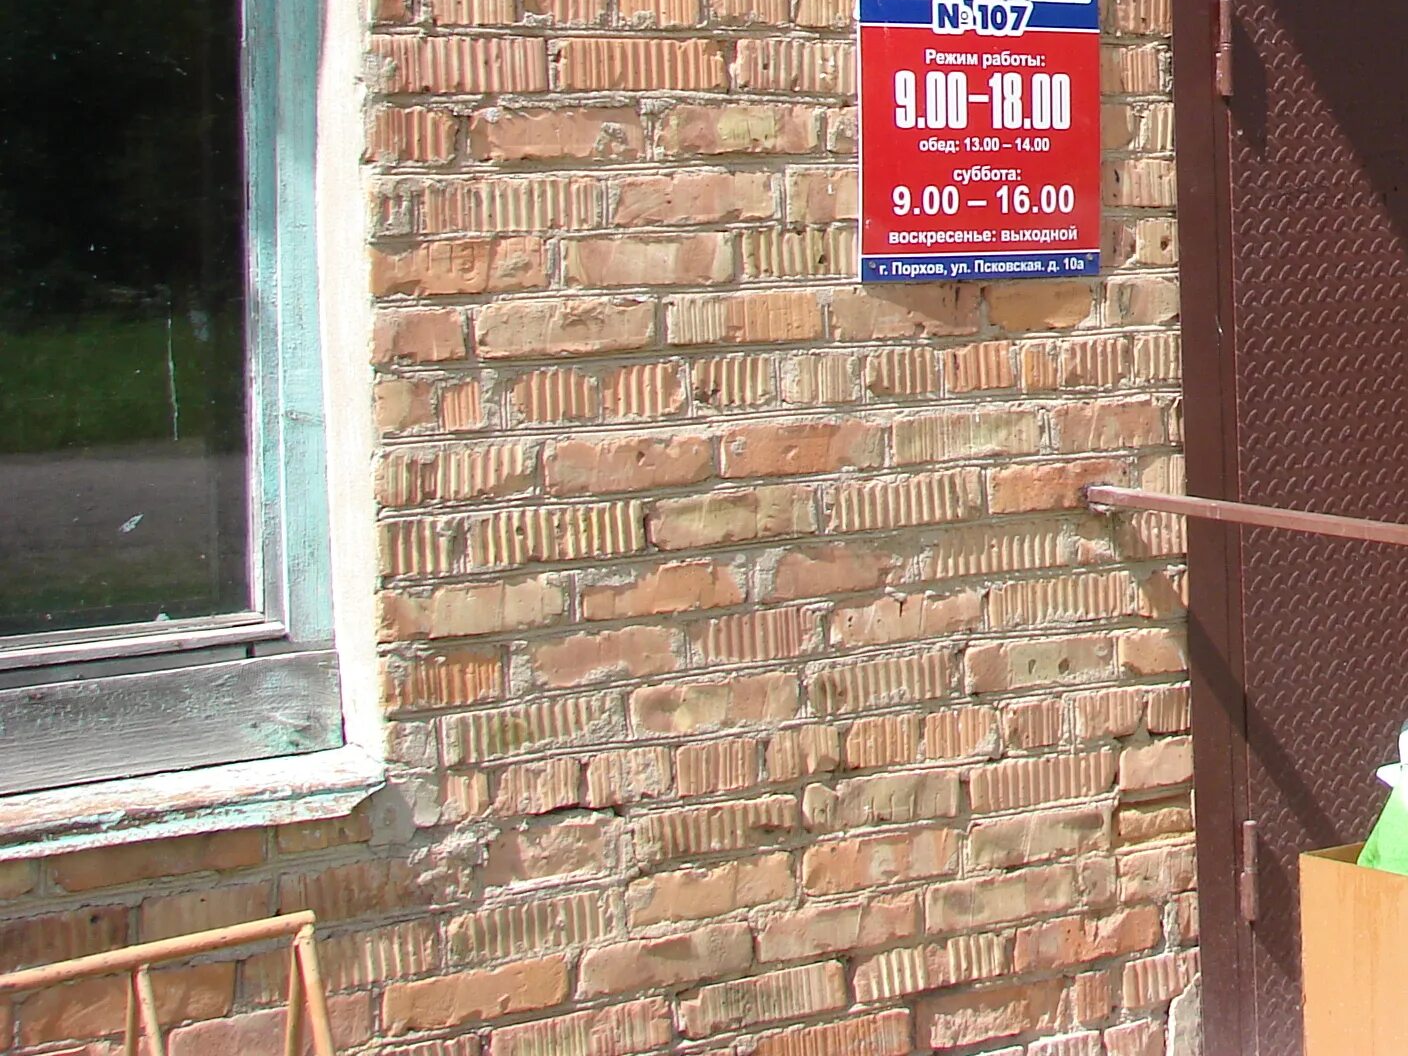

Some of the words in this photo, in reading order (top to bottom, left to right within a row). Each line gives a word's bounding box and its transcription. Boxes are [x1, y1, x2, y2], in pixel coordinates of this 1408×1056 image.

[938, 3, 969, 29] №
[979, 4, 1027, 31] 107
[925, 49, 978, 65] Режим
[982, 51, 1046, 69] работы:
[919, 137, 960, 152] обед:
[964, 137, 1000, 151] 13.00
[1015, 137, 1050, 152] 14.00
[953, 166, 1022, 184] суббота:
[892, 186, 959, 215] 9.00
[996, 185, 1075, 214] 16.00
[889, 230, 997, 247] воскресенье:
[1001, 226, 1078, 242] выходной
[879, 265, 887, 276] г.
[892, 262, 947, 278] Порхов,
[951, 263, 971, 276] ул.
[1047, 259, 1060, 272] д.
[1063, 257, 1084, 271] 10а
